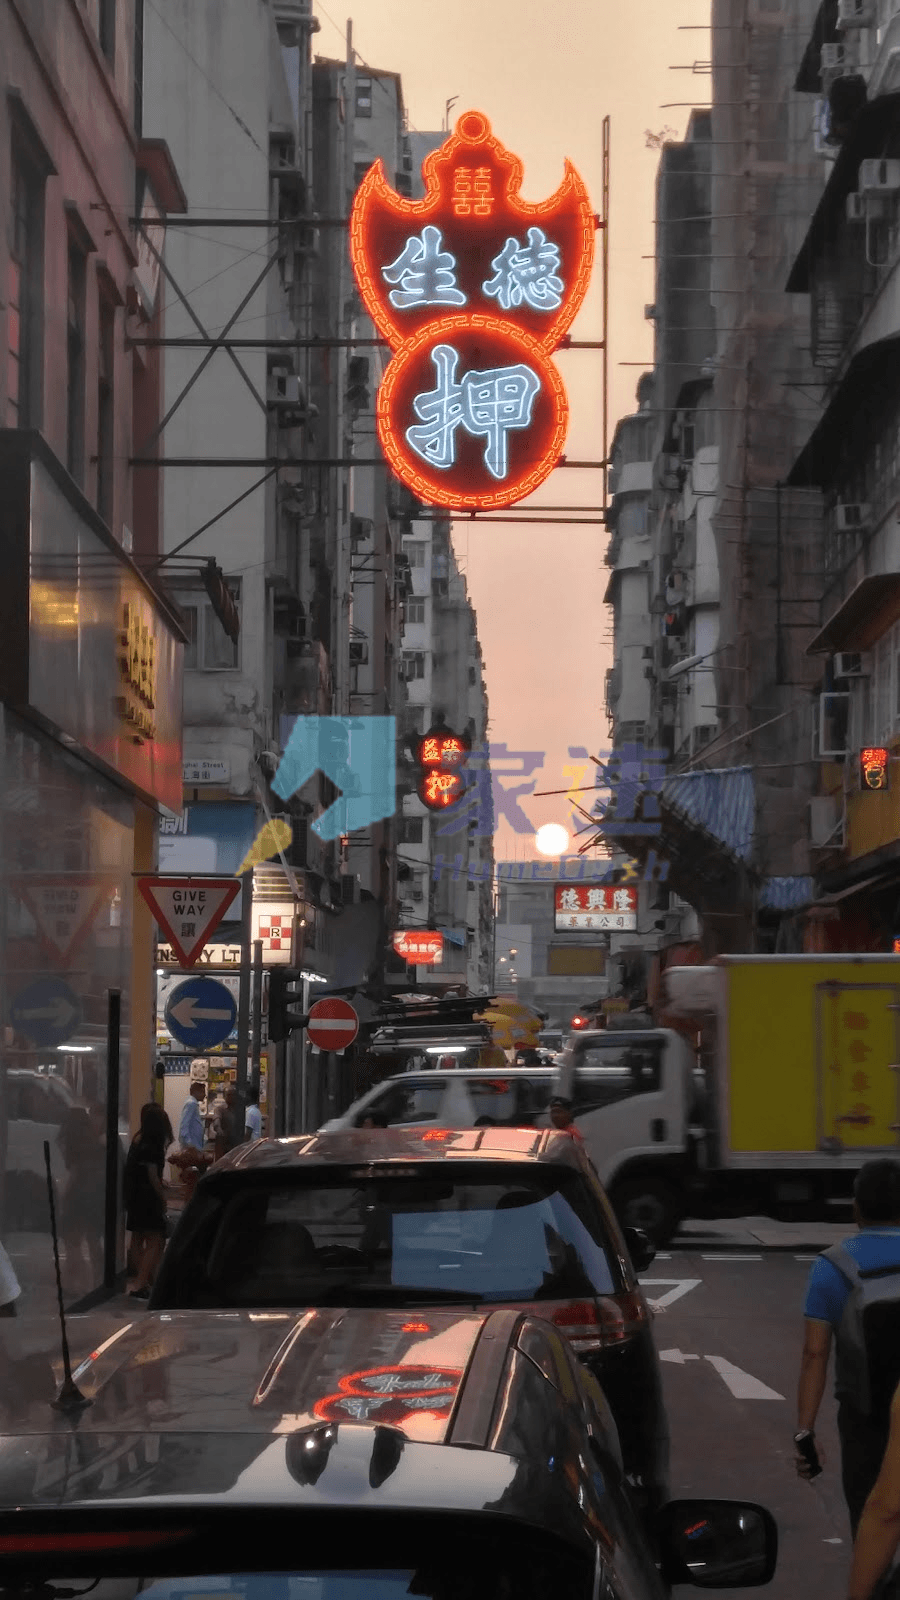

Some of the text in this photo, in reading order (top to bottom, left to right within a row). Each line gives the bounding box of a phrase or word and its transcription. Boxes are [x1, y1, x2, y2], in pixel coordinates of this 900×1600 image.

[405, 344, 541, 480] 押
[172, 890, 206, 902] GIVE
[560, 887, 633, 911] 德興隆
[173, 905, 205, 915] WAY
